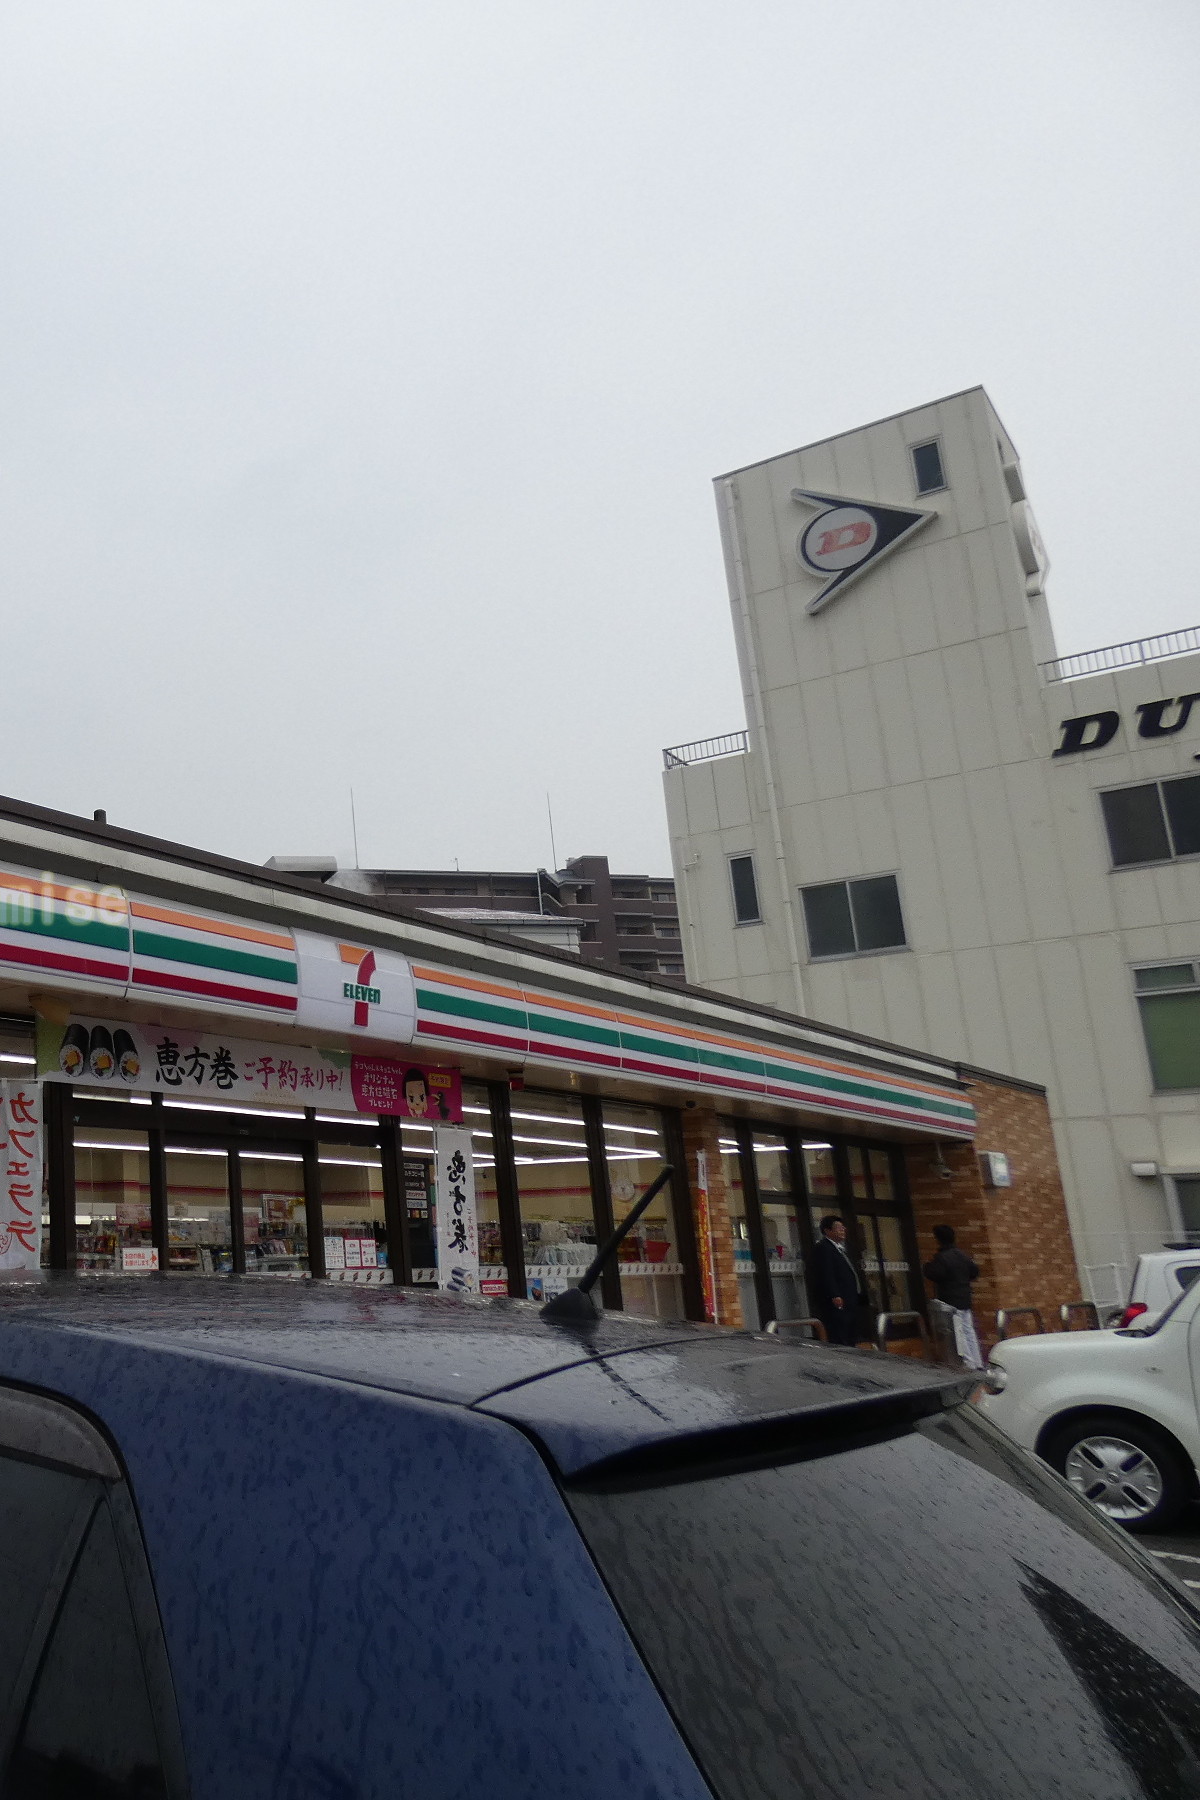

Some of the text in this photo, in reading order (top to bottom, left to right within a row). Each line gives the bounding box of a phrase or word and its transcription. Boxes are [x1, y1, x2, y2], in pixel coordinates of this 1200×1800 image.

[155, 1036, 344, 1092] 恵方巻 ご予約承り中!
